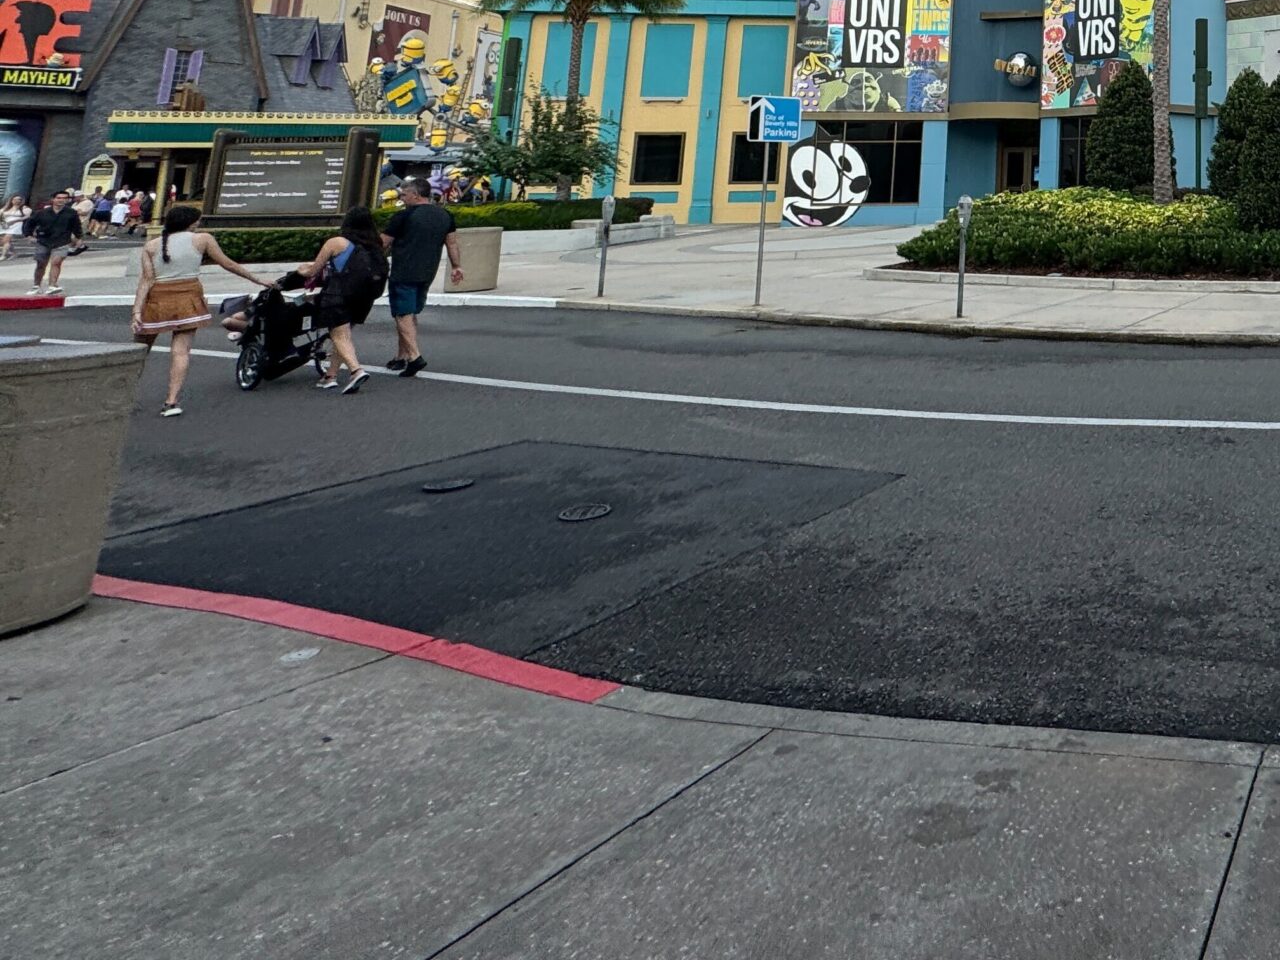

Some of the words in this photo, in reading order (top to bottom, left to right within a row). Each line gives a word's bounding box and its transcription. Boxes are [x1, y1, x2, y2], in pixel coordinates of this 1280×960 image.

[385, 9, 407, 24] JOIN
[409, 15, 421, 27] US
[1078, 17, 1116, 56] VRS
[848, 28, 901, 64] VRS
[2, 69, 73, 86] MAYHEM
[765, 114, 777, 122] City
[764, 127, 798, 139] Parking
